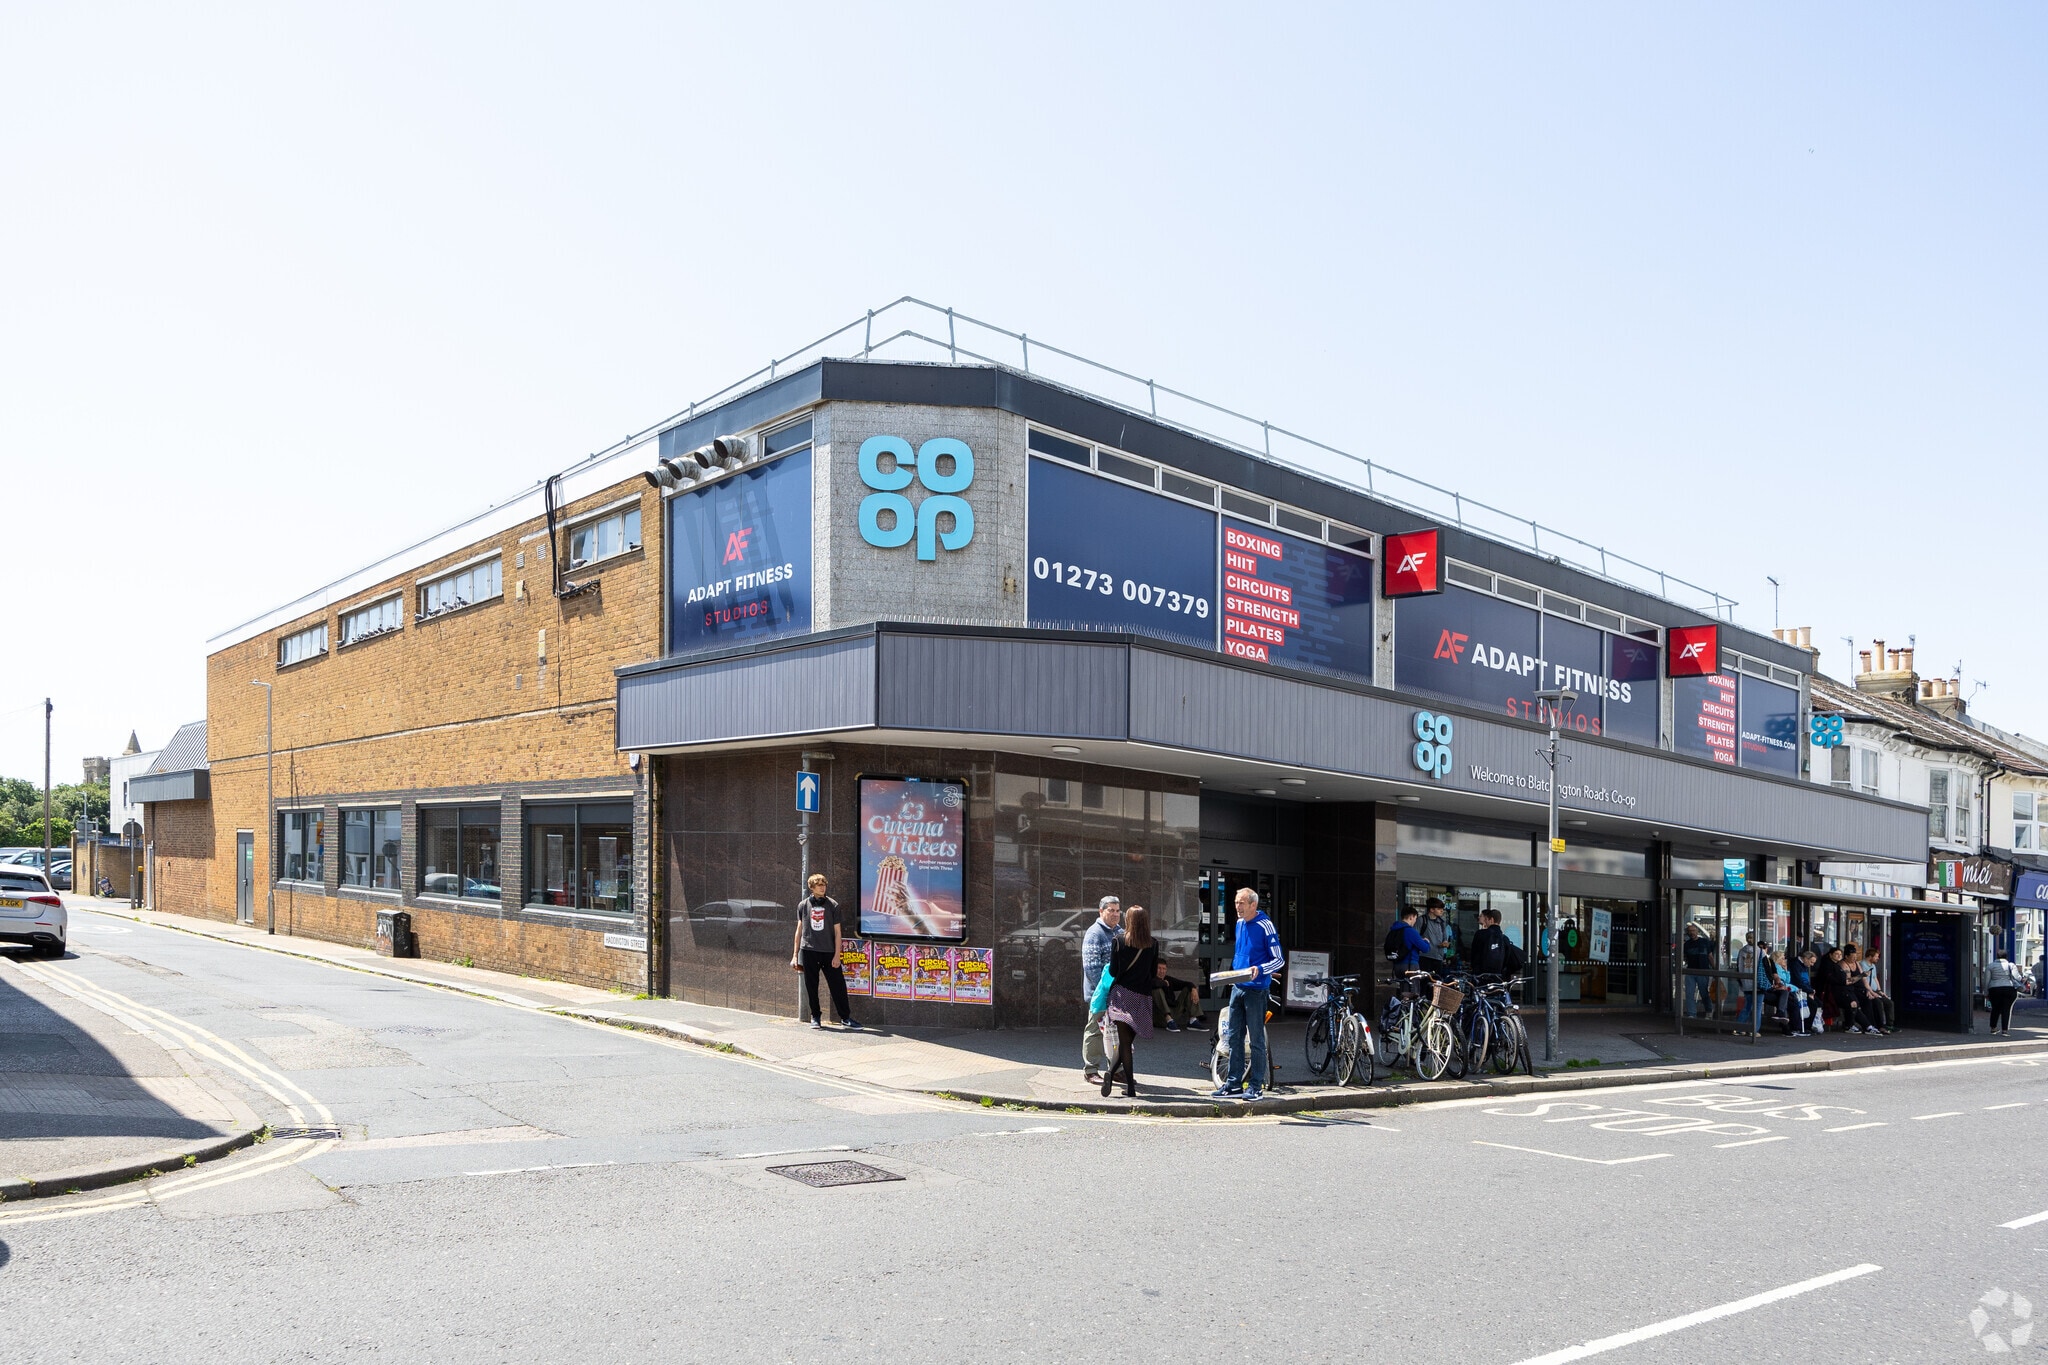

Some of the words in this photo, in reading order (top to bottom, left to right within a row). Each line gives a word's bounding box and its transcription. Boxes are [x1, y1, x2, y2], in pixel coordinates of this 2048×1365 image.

[1226, 530, 1281, 558] BOXING
[1226, 553, 1255, 572] HIIT
[1396, 552, 1427, 574] AF
[687, 571, 731, 604] ADAPT
[735, 562, 793, 593] FITNESS
[1033, 556, 1114, 596] 01273
[1122, 579, 1210, 619] 007379
[1226, 575, 1290, 602] CIRCUITS
[705, 600, 769, 627] STUDIOS
[1226, 597, 1299, 626] STRENGTH
[1226, 618, 1283, 643] PILATES
[1226, 640, 1266, 661] YOGA
[1434, 629, 1469, 664] AF
[1680, 642, 1707, 660] AF
[1472, 643, 1548, 682] ADAPT
[1555, 664, 1632, 704] FITNESS
[1708, 675, 1735, 689] BOXING
[1720, 692, 1734, 704] HIIT
[1703, 702, 1734, 718] CIRCUITS
[1698, 716, 1734, 733] STRENGTH
[1706, 734, 1734, 748] PILATES
[1742, 731, 1795, 750] ADAPT-FITNESS.COM
[1714, 751, 1734, 763] YOGA
[1470, 765, 1514, 786] Welcome
[1516, 775, 1526, 788] to
[1528, 775, 1581, 799] Blatcngton
[1583, 785, 1609, 801] Road's
[1611, 790, 1636, 809] Co-op
[898, 801, 924, 820] £3
[868, 815, 944, 837] Cinema
[887, 835, 957, 857] Tickets
[1962, 861, 1992, 885] mici
[630, 939, 645, 949] STREET
[840, 952, 866, 960] CIRCUS
[879, 956, 908, 965] CIRCUS
[918, 959, 947, 967] CIRCUS
[958, 961, 987, 969] CIRCUS
[1642, 1094, 1867, 1121] BUS
[1481, 1102, 1772, 1136] STOP
